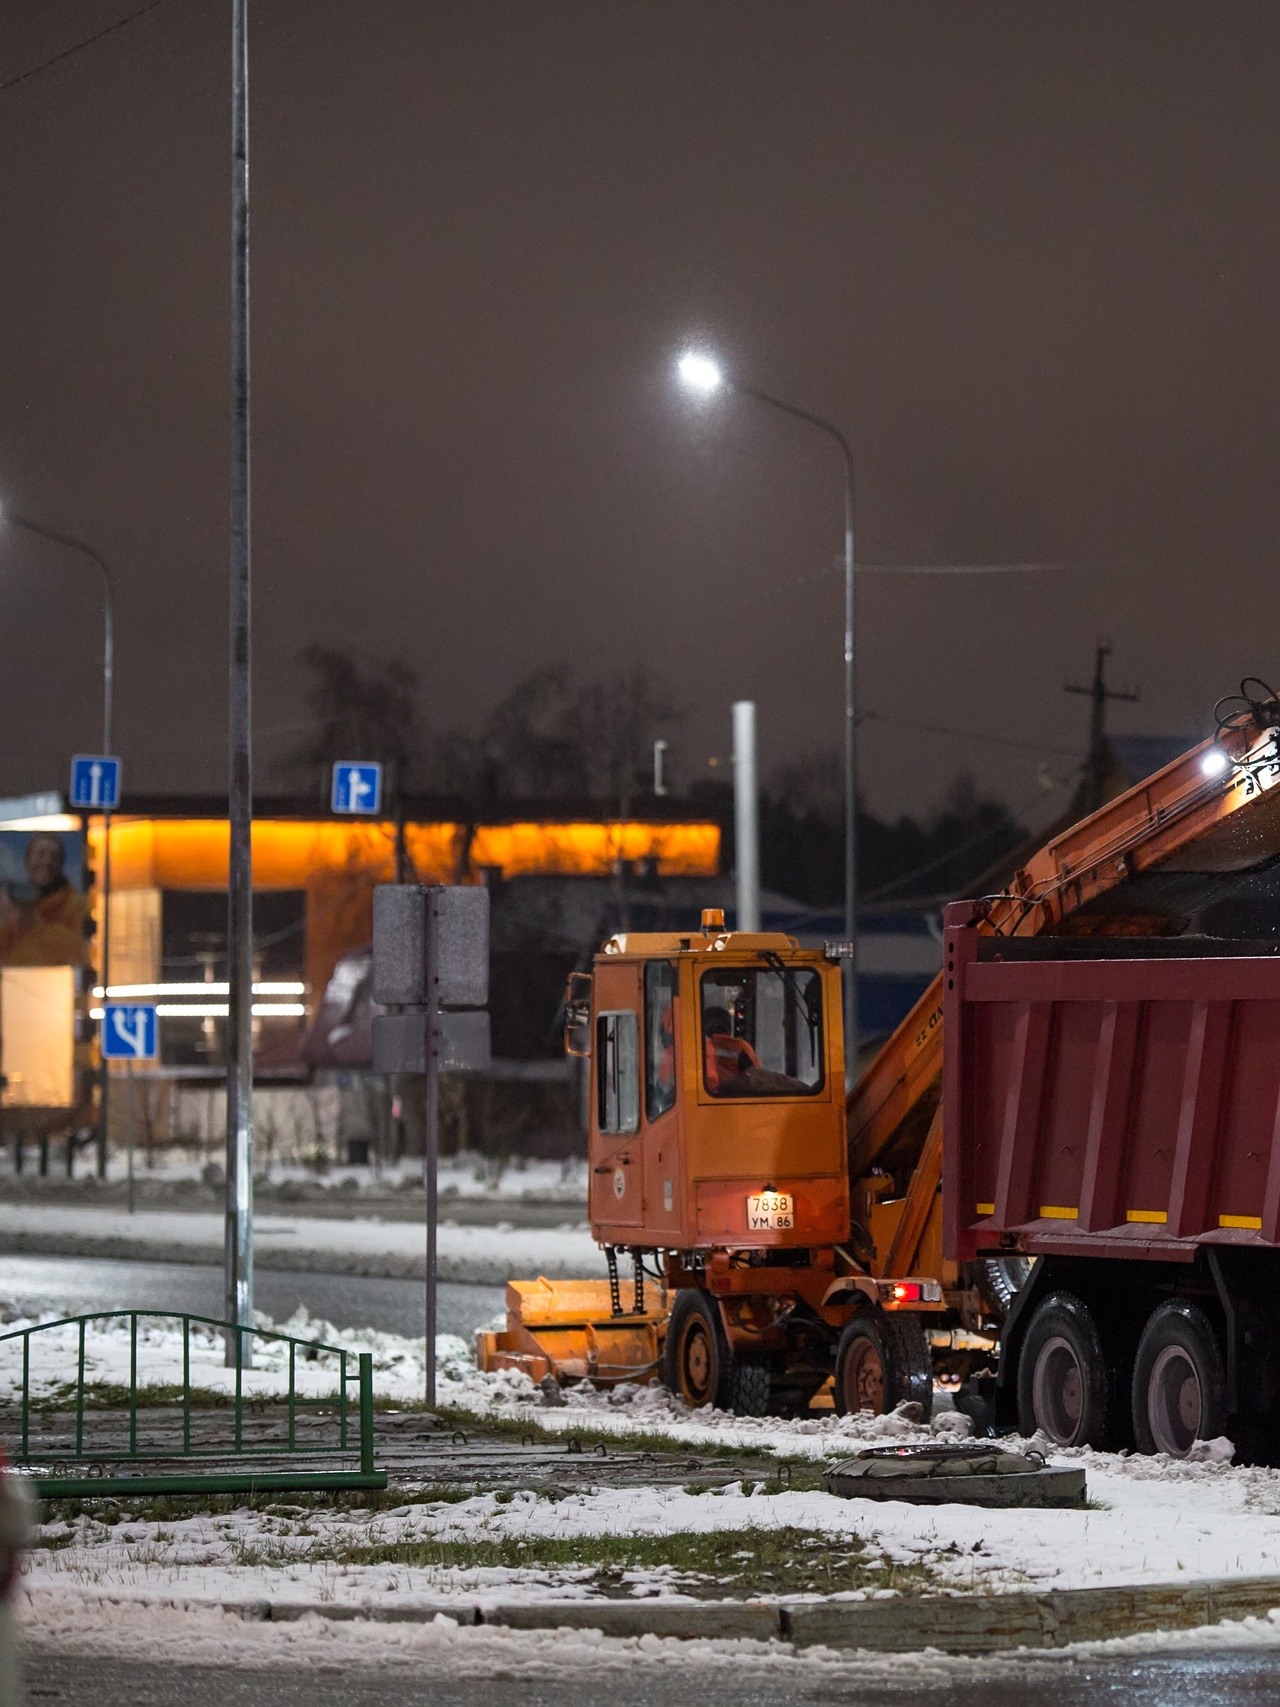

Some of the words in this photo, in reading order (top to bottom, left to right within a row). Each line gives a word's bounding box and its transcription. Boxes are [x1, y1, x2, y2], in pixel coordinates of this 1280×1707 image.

[753, 1197, 788, 1211] 7838
[752, 1217, 769, 1228] УМ
[777, 1216, 791, 1227] 86
